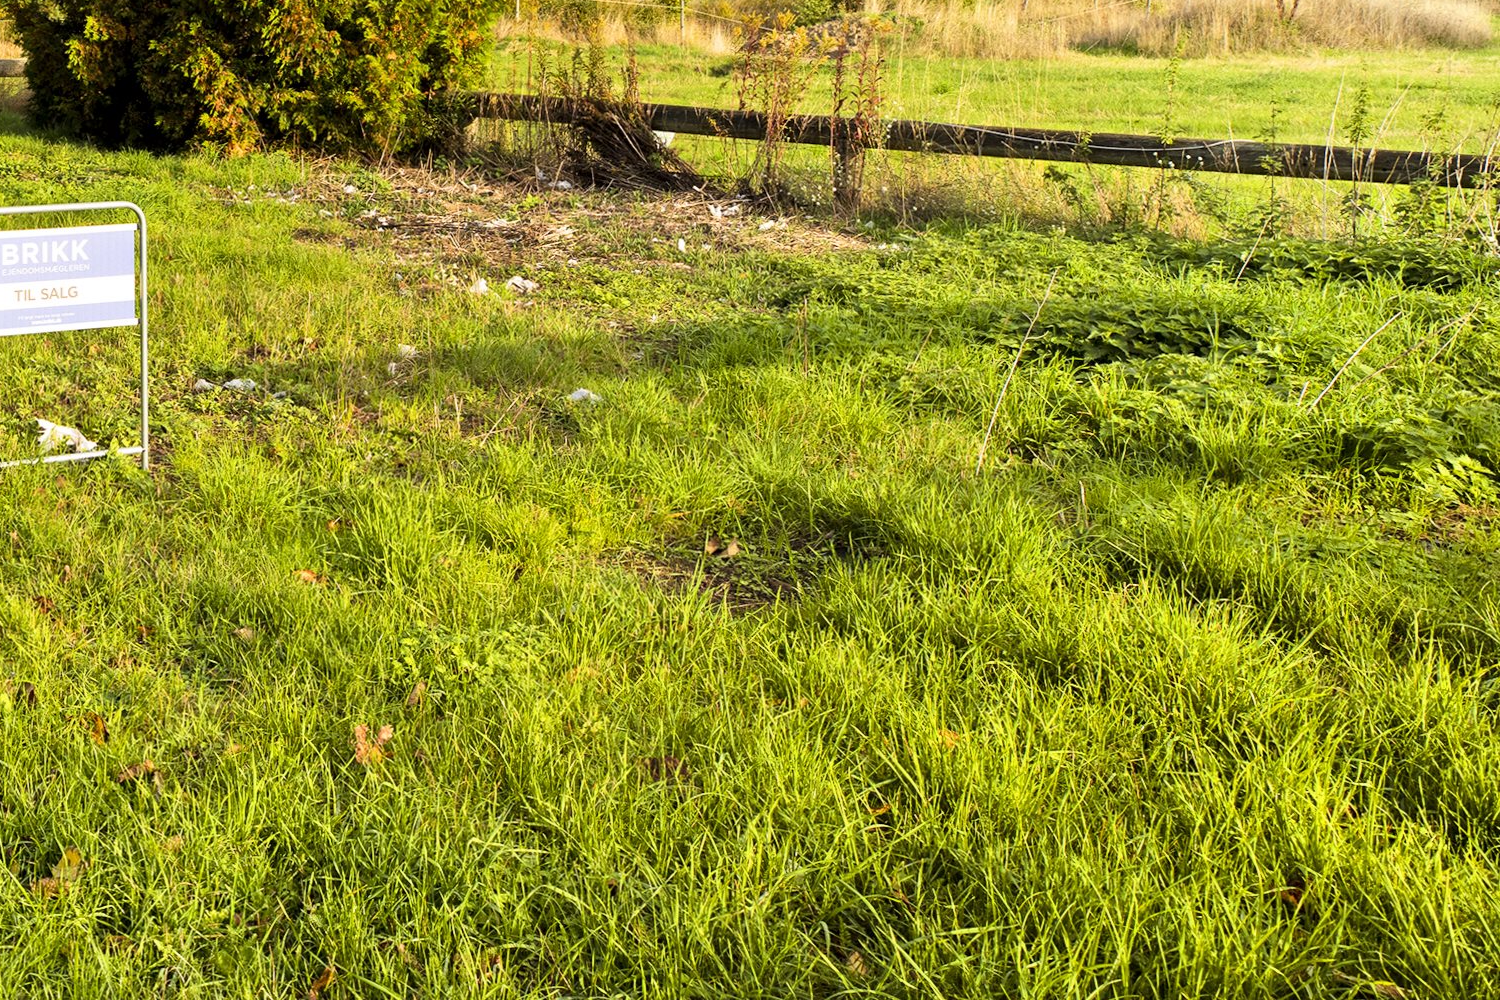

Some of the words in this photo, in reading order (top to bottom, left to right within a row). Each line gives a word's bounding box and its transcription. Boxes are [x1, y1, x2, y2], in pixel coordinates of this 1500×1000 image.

[1, 239, 89, 266] BRIKK
[14, 289, 36, 302] TIL
[41, 286, 79, 300] SALG
